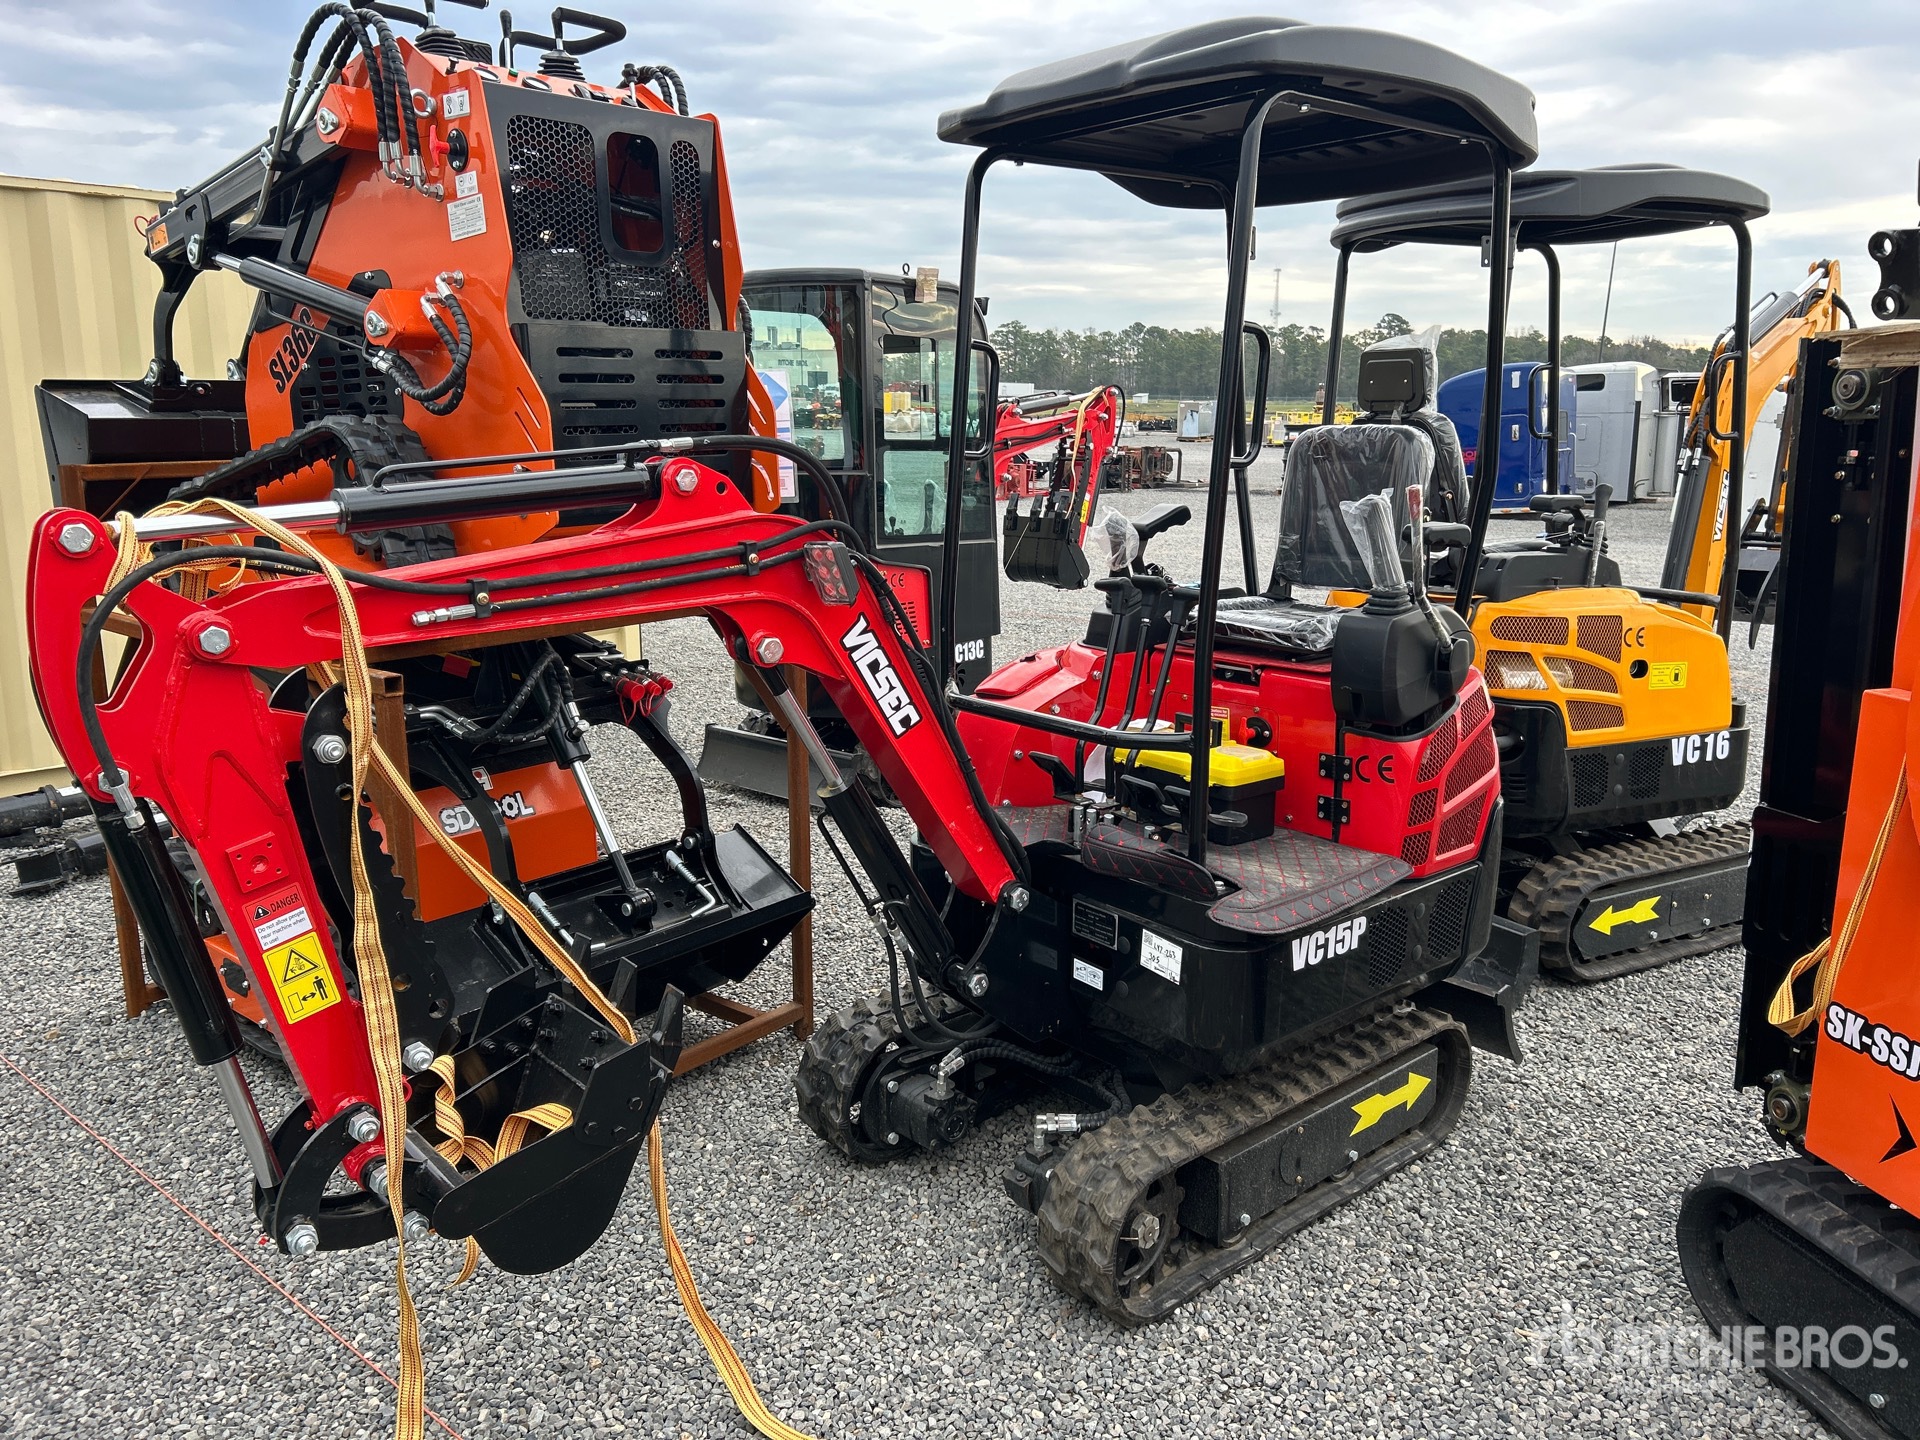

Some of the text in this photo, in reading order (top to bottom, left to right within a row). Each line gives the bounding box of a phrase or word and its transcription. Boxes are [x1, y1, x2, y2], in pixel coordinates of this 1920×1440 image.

[954, 639, 985, 663] C13C
[842, 614, 921, 737] VICSEC
[270, 893, 300, 913] DANGER
[260, 917, 306, 941] near machine when
[266, 921, 275, 931] not
[275, 917, 288, 926] allow
[288, 909, 305, 922] people
[1291, 915, 1367, 972] VC15P
